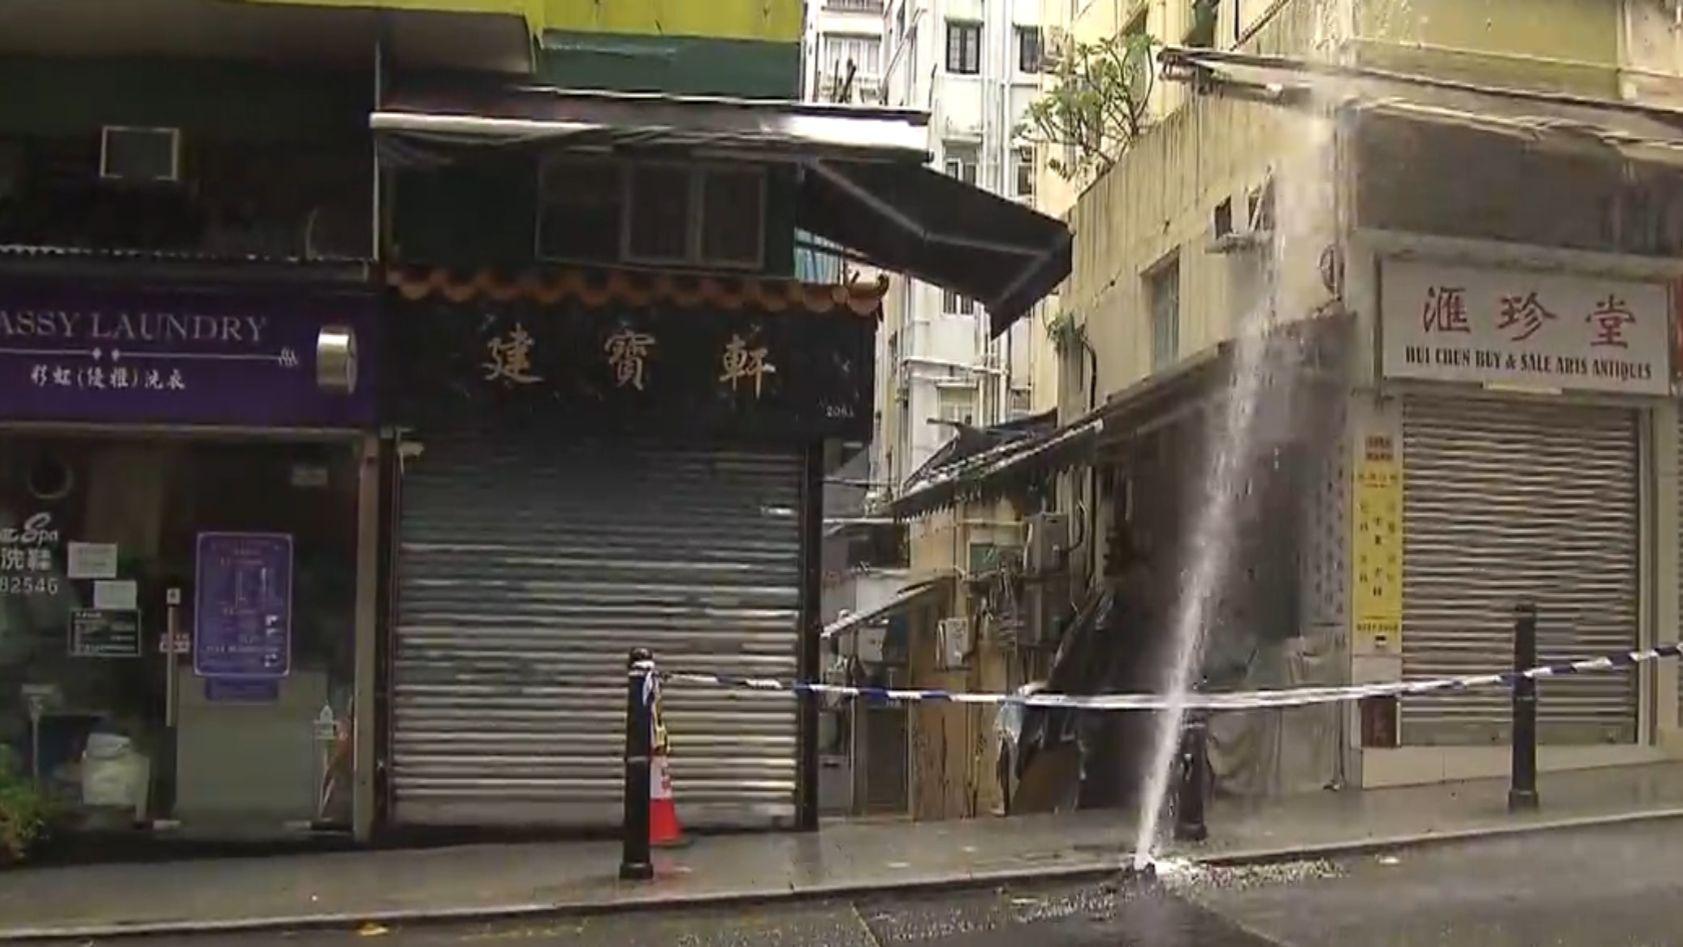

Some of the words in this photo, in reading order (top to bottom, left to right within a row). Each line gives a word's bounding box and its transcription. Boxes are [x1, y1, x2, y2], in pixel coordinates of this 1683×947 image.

[91, 312, 267, 342] LAUNDRY
[483, 322, 775, 399] 建寶軒
[1405, 346, 1430, 364] HUI
[1475, 349, 1501, 369] BUY
[1505, 354, 1517, 370] &
[1520, 353, 1552, 373] SALE
[1556, 356, 1588, 375] ARTS
[1592, 358, 1652, 381] ANTIQUES
